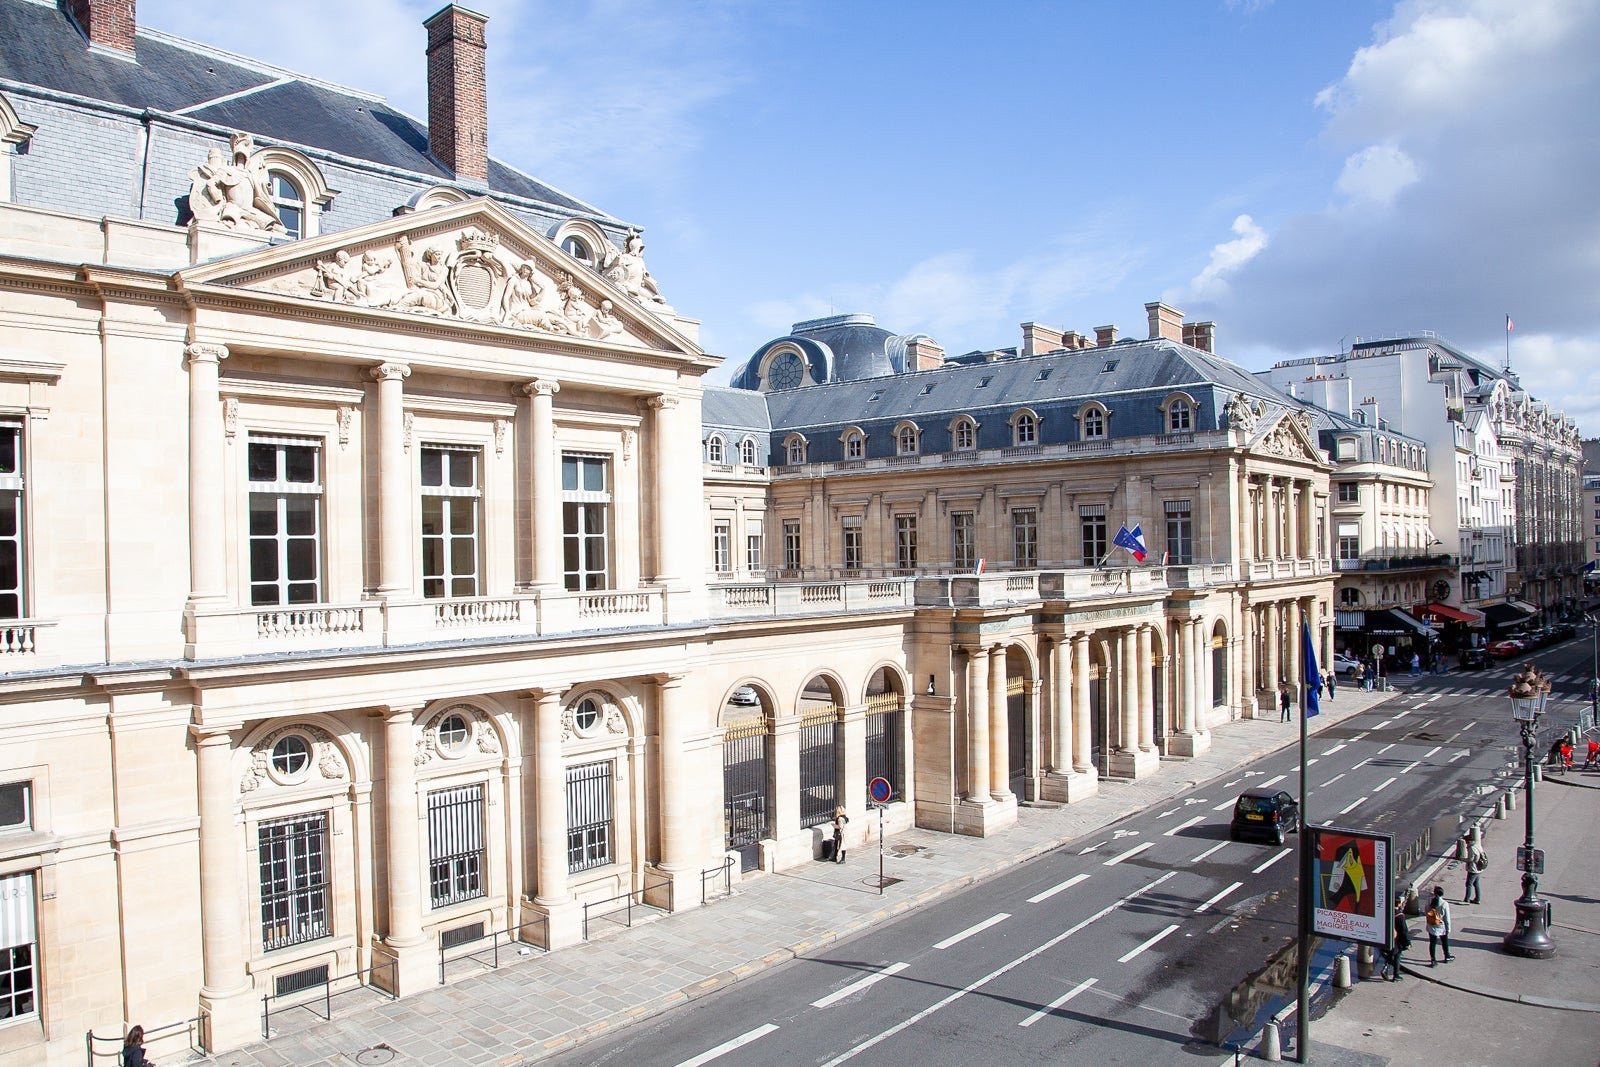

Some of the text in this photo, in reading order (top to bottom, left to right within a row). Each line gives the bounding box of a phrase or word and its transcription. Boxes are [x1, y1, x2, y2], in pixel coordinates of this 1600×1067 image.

[1317, 910, 1348, 919] PICASSO
[1317, 921, 1354, 931] MAGIQUES
[1333, 918, 1370, 929] TABLEAUX
